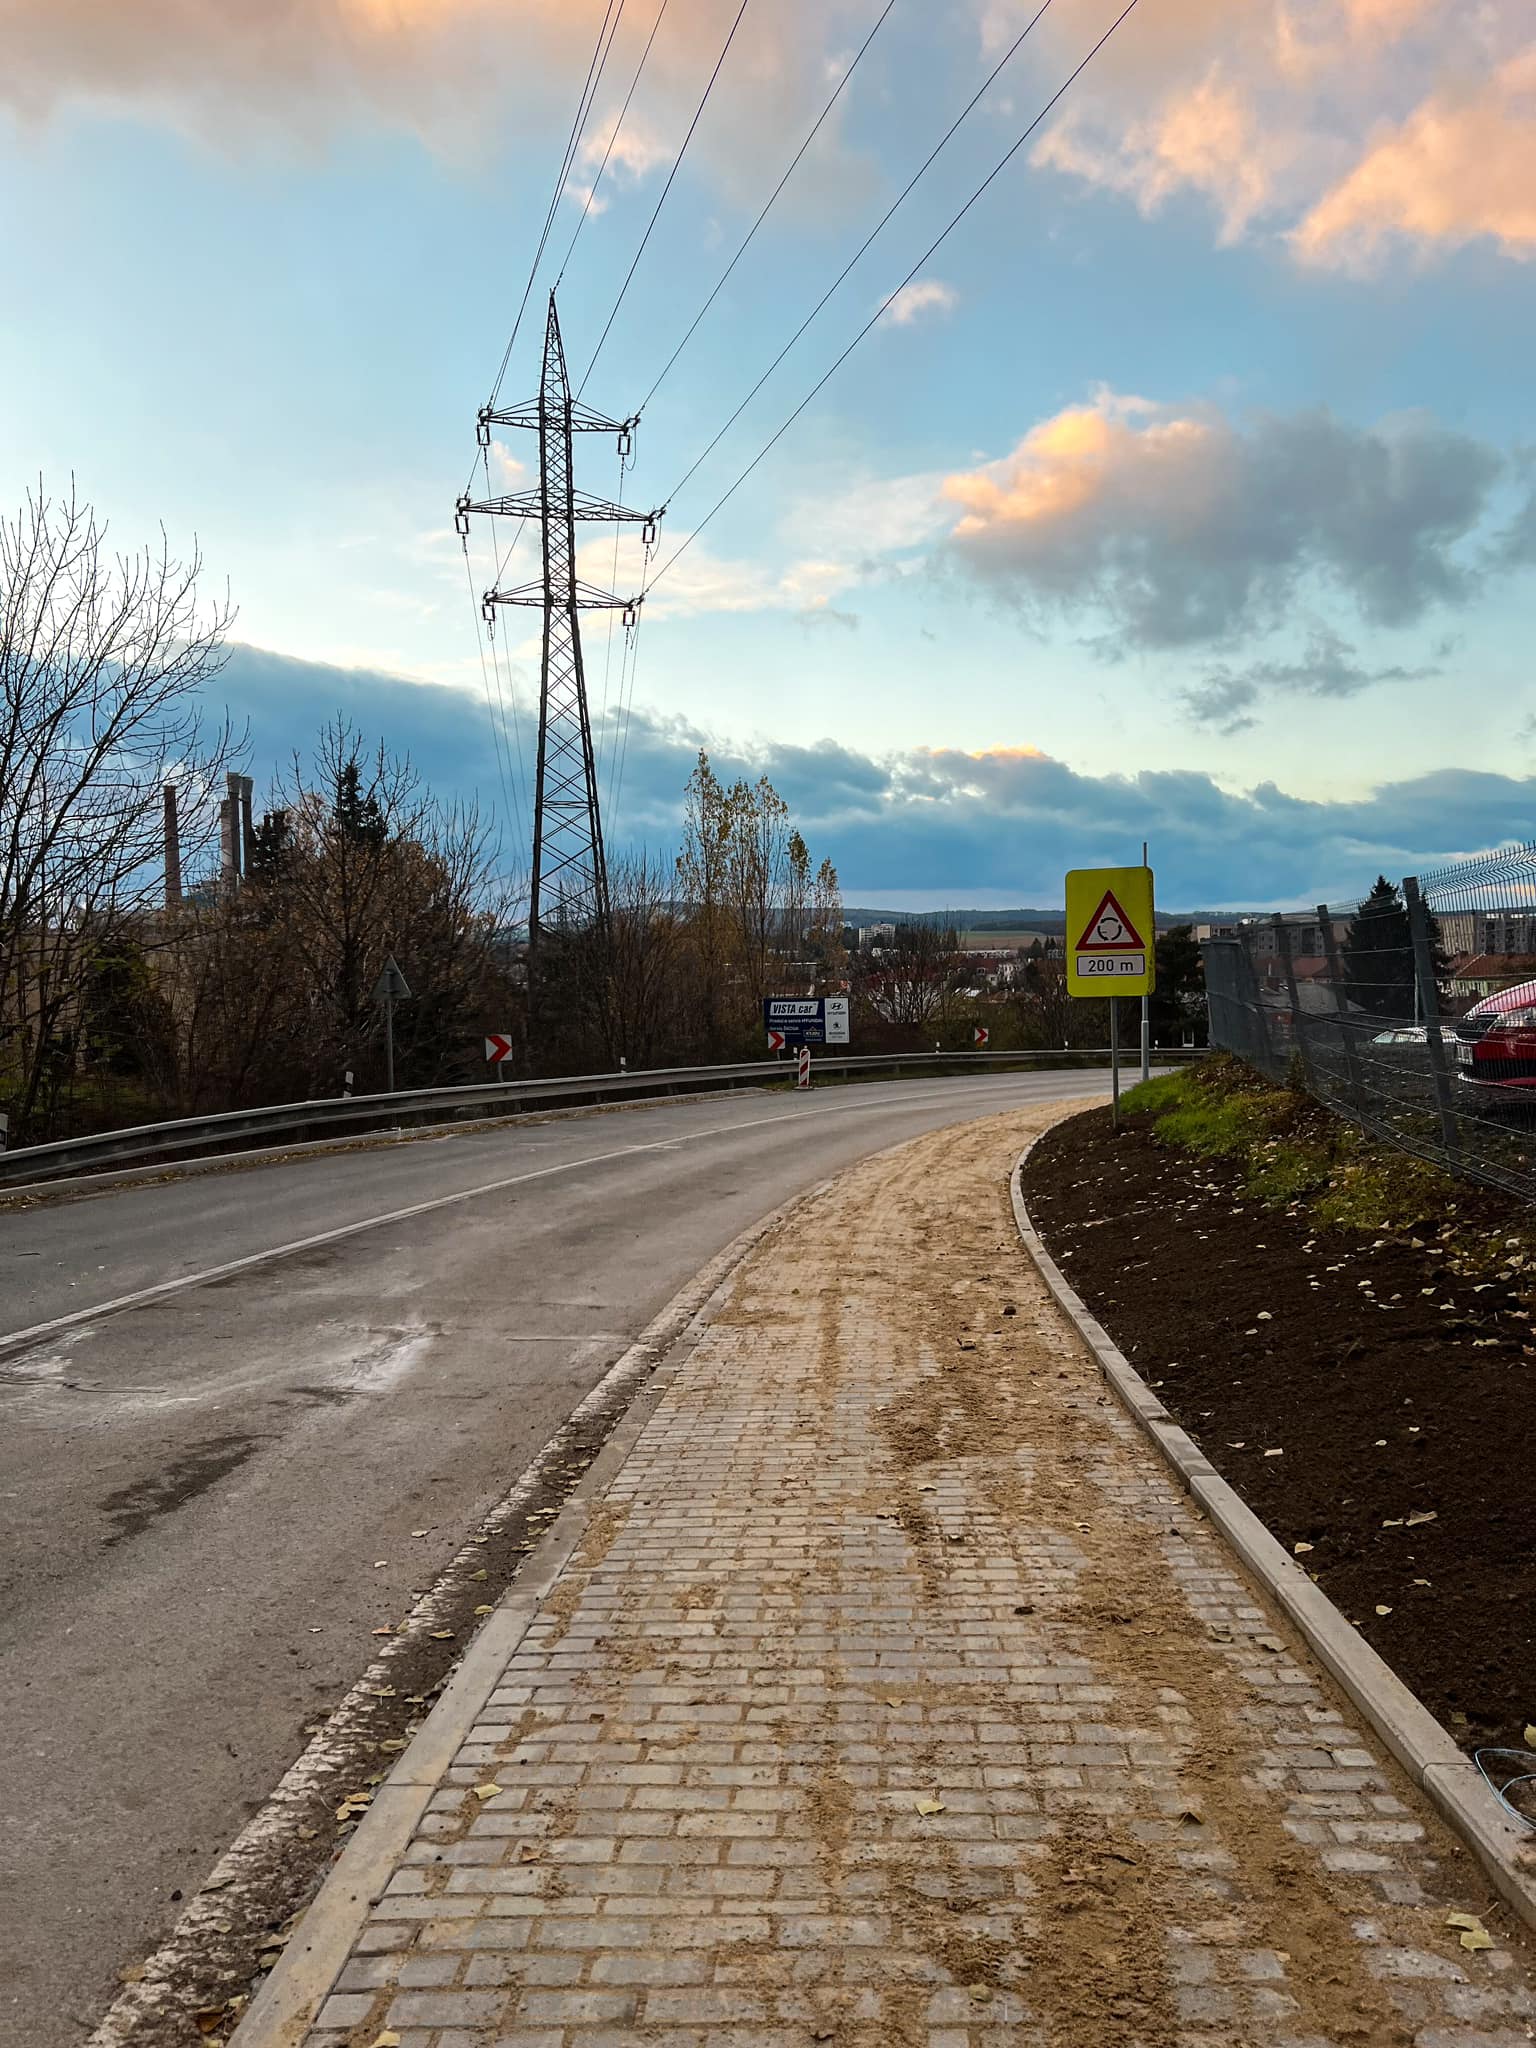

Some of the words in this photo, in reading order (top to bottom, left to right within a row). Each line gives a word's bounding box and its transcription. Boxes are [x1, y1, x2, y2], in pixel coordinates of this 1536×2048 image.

[1088, 959, 1114, 972] 200
[1120, 961, 1134, 972] m
[773, 1003, 796, 1014] VISTA
[798, 1004, 813, 1014] car
